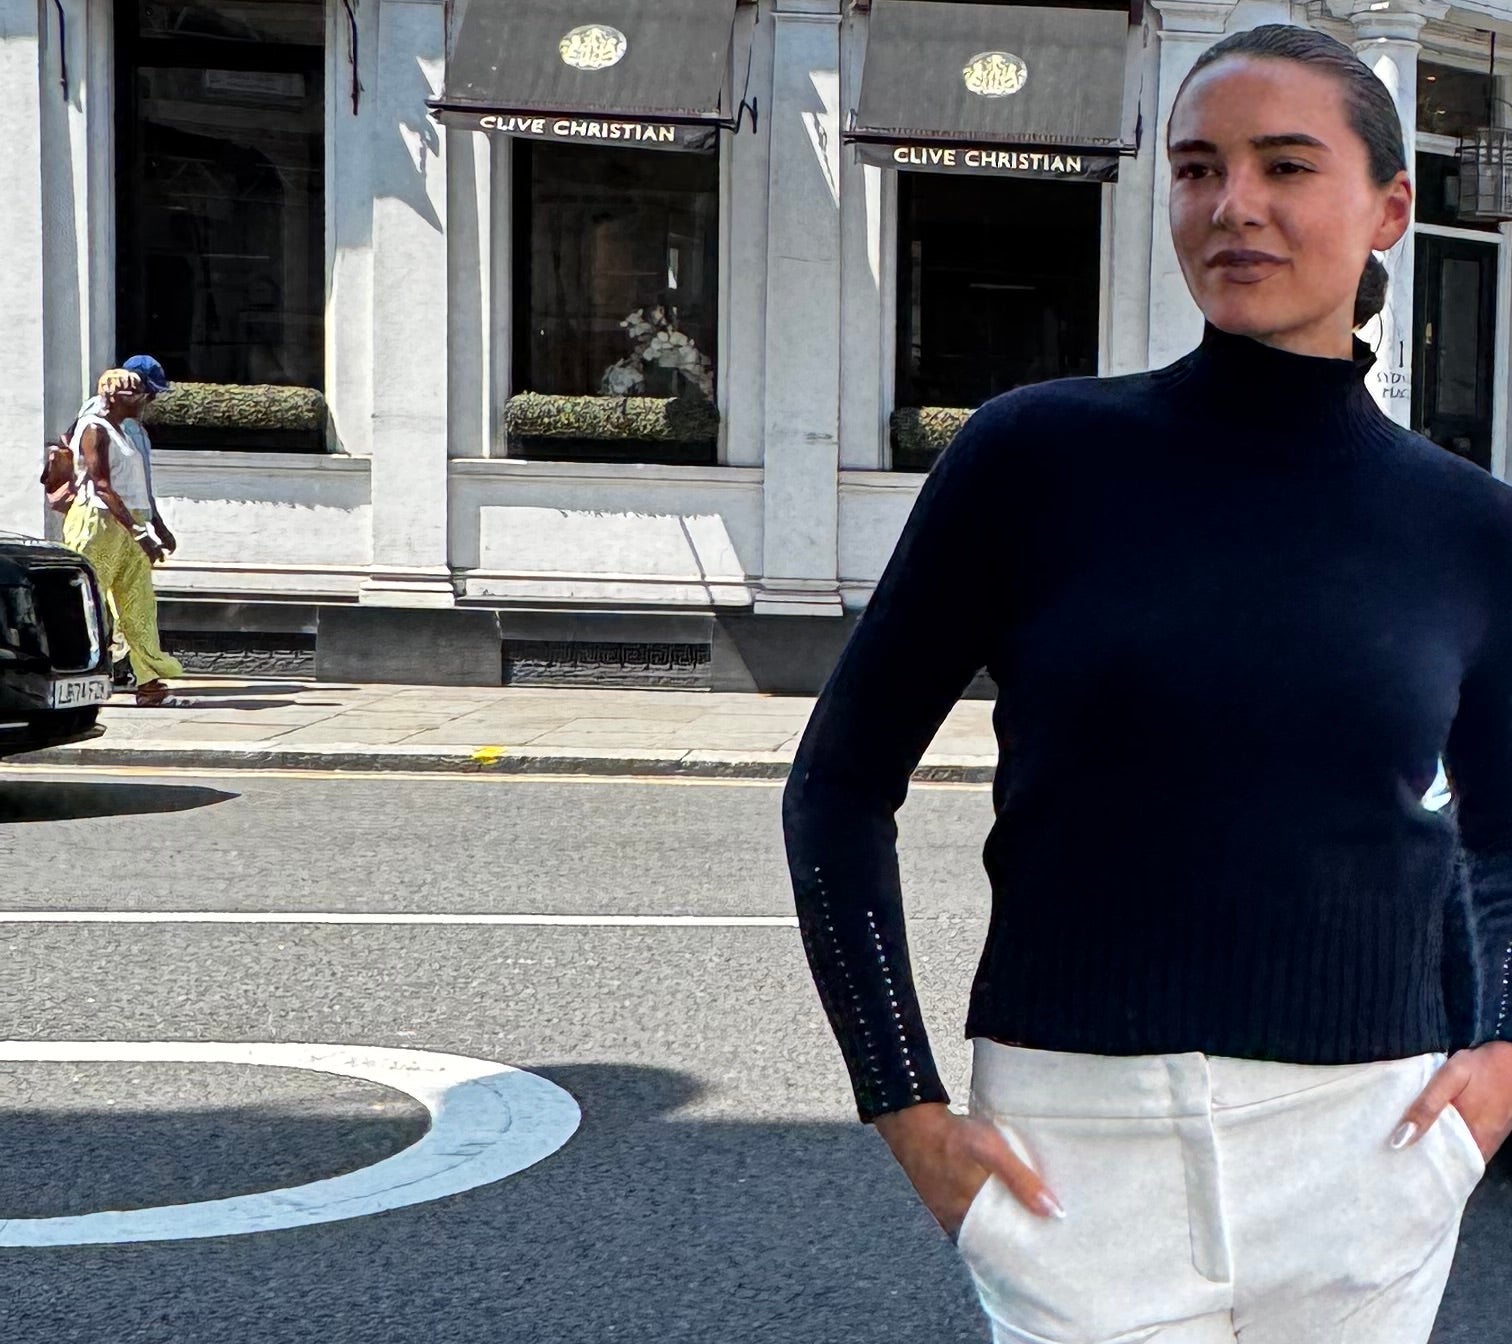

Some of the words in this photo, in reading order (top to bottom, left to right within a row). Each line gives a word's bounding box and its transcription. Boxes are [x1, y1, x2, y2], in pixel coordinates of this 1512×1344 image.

[479, 116, 546, 134] CLIVE
[553, 120, 675, 142] CHRISTIAN
[893, 147, 957, 166] CLIVE
[964, 150, 1082, 172] CHRISTIAN
